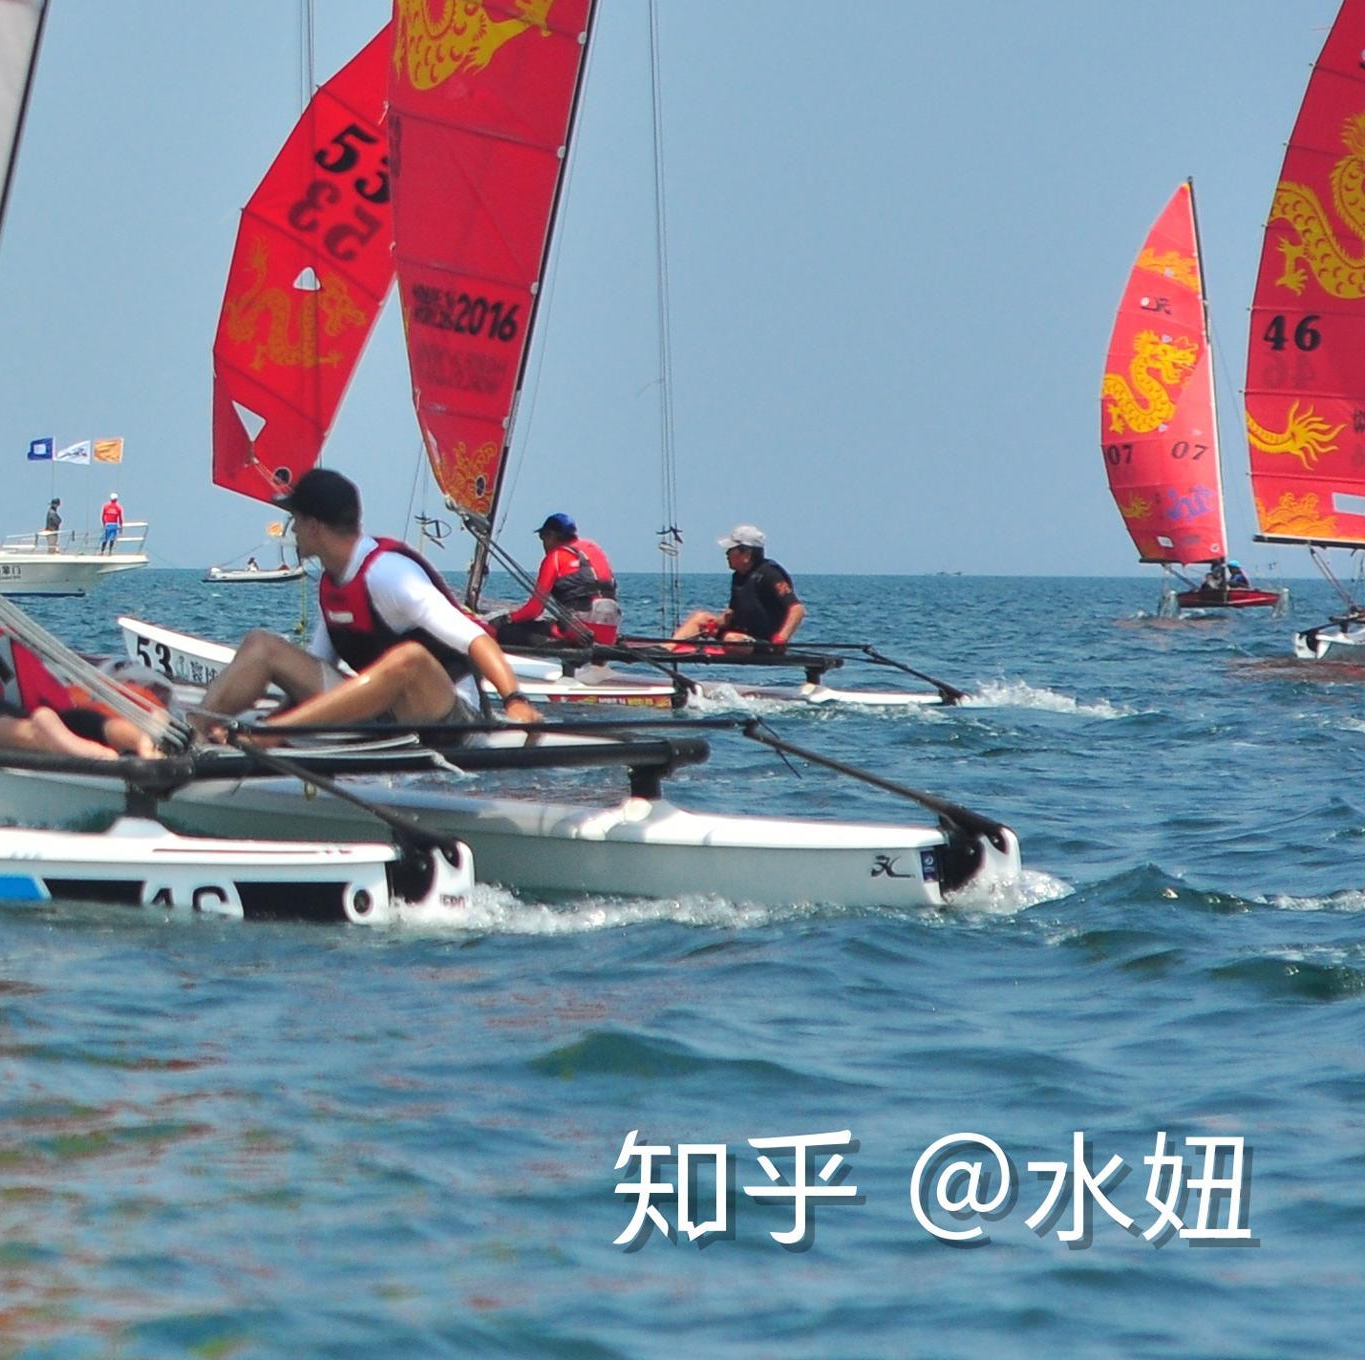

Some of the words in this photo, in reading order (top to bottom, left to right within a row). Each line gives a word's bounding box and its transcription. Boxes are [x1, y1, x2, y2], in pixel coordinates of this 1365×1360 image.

[454, 293, 521, 343] 2016
[1263, 314, 1322, 352] 46
[1172, 441, 1208, 460] 07
[137, 635, 174, 680] 53
